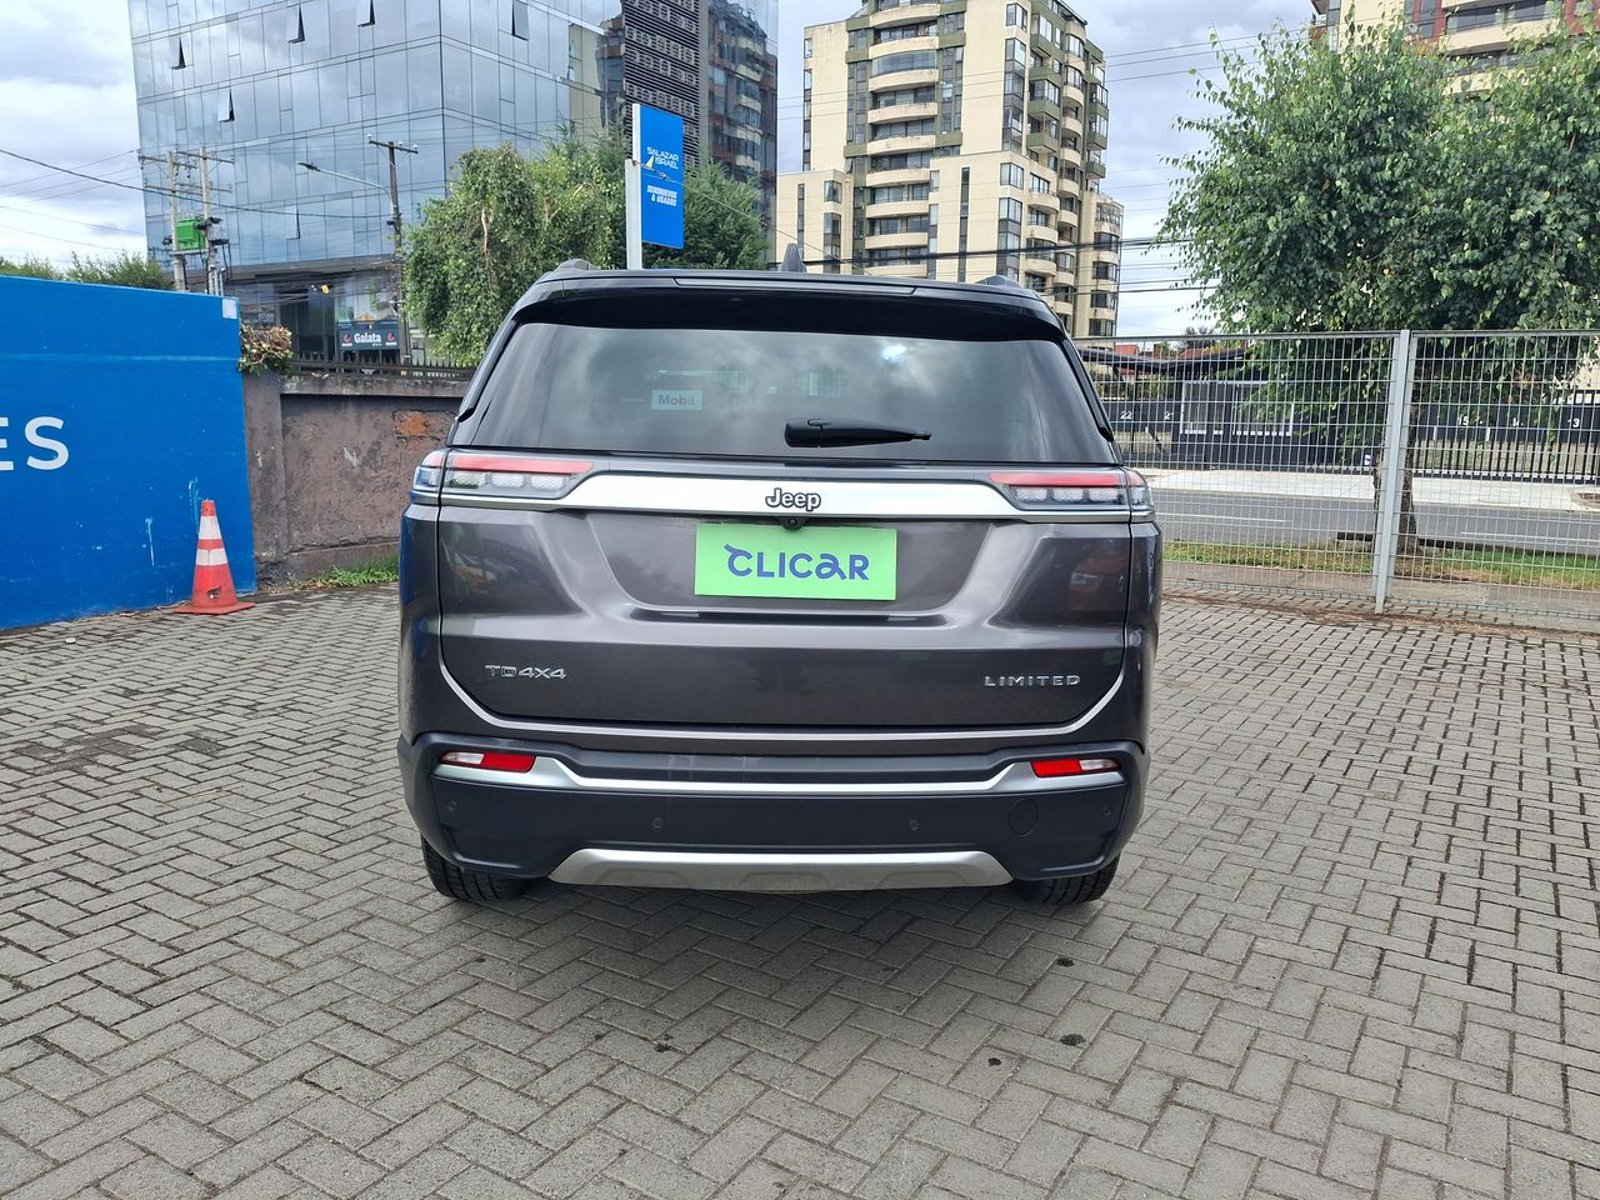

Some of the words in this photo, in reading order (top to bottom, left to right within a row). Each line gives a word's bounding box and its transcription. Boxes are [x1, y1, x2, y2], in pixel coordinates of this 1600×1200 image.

[647, 146, 679, 162] SALAZAR
[655, 155, 679, 170] ISRAEL
[354, 332, 381, 343] Galata
[765, 487, 822, 511] Jeep
[983, 674, 1081, 687] LIMITED
